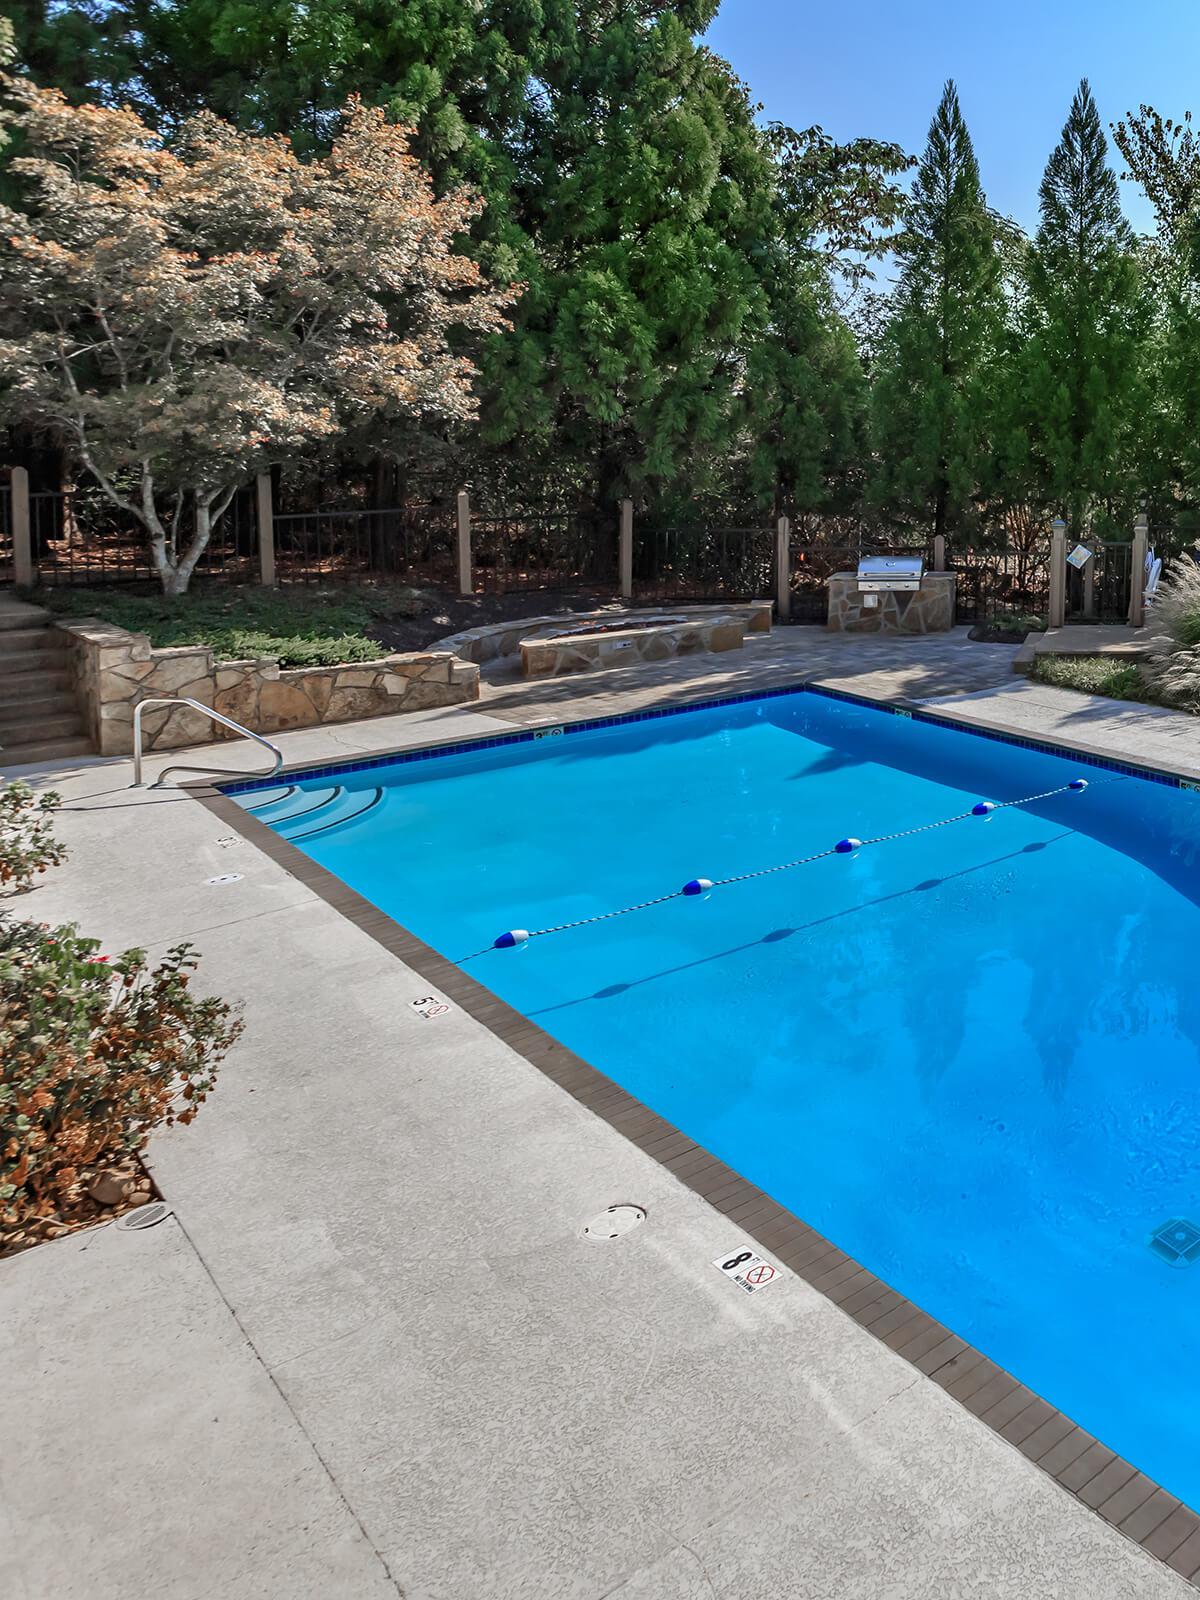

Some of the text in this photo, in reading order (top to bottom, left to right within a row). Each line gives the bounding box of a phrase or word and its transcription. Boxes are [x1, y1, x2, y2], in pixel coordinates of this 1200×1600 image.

[413, 997, 434, 1005] 5
[722, 1251, 753, 1270] 8
[734, 1275, 756, 1293] NO DIVING
